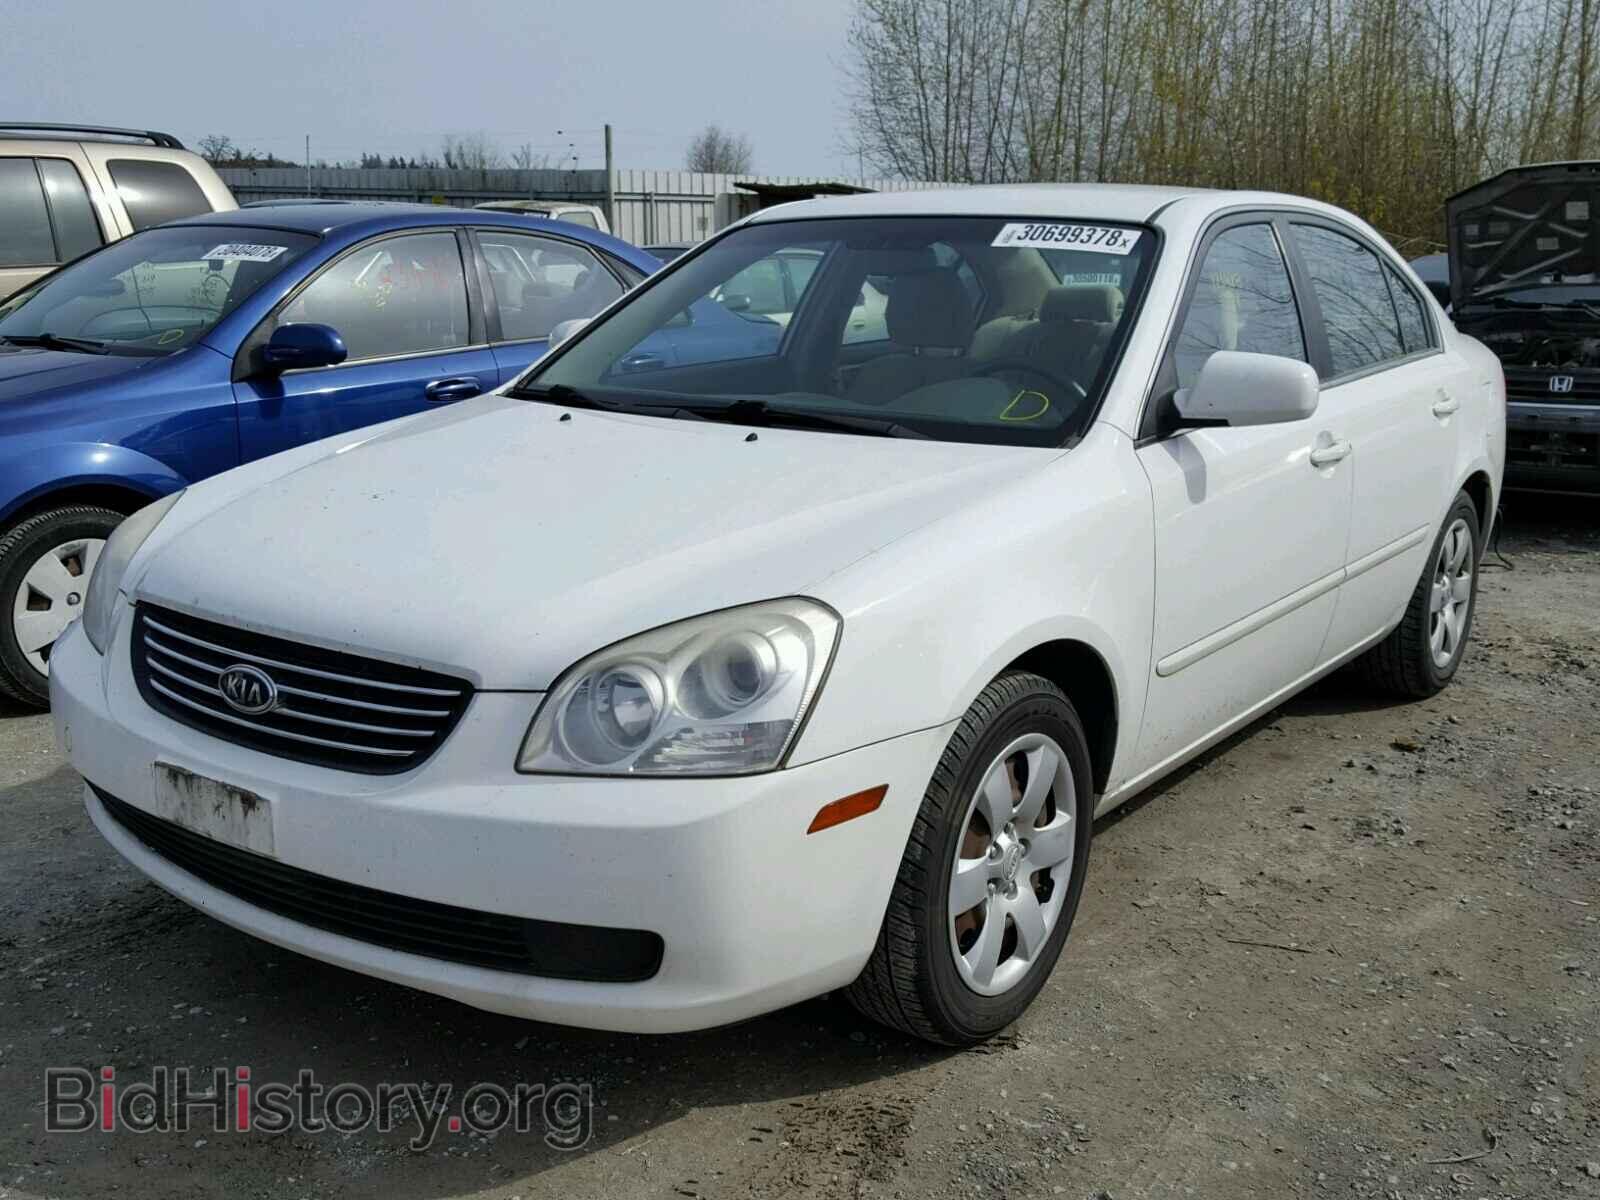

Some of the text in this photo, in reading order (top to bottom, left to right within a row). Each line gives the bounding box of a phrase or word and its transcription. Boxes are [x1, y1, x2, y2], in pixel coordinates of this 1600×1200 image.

[1016, 224, 1123, 247] 30699378
[999, 389, 1049, 421] D
[226, 673, 263, 705] KIA
